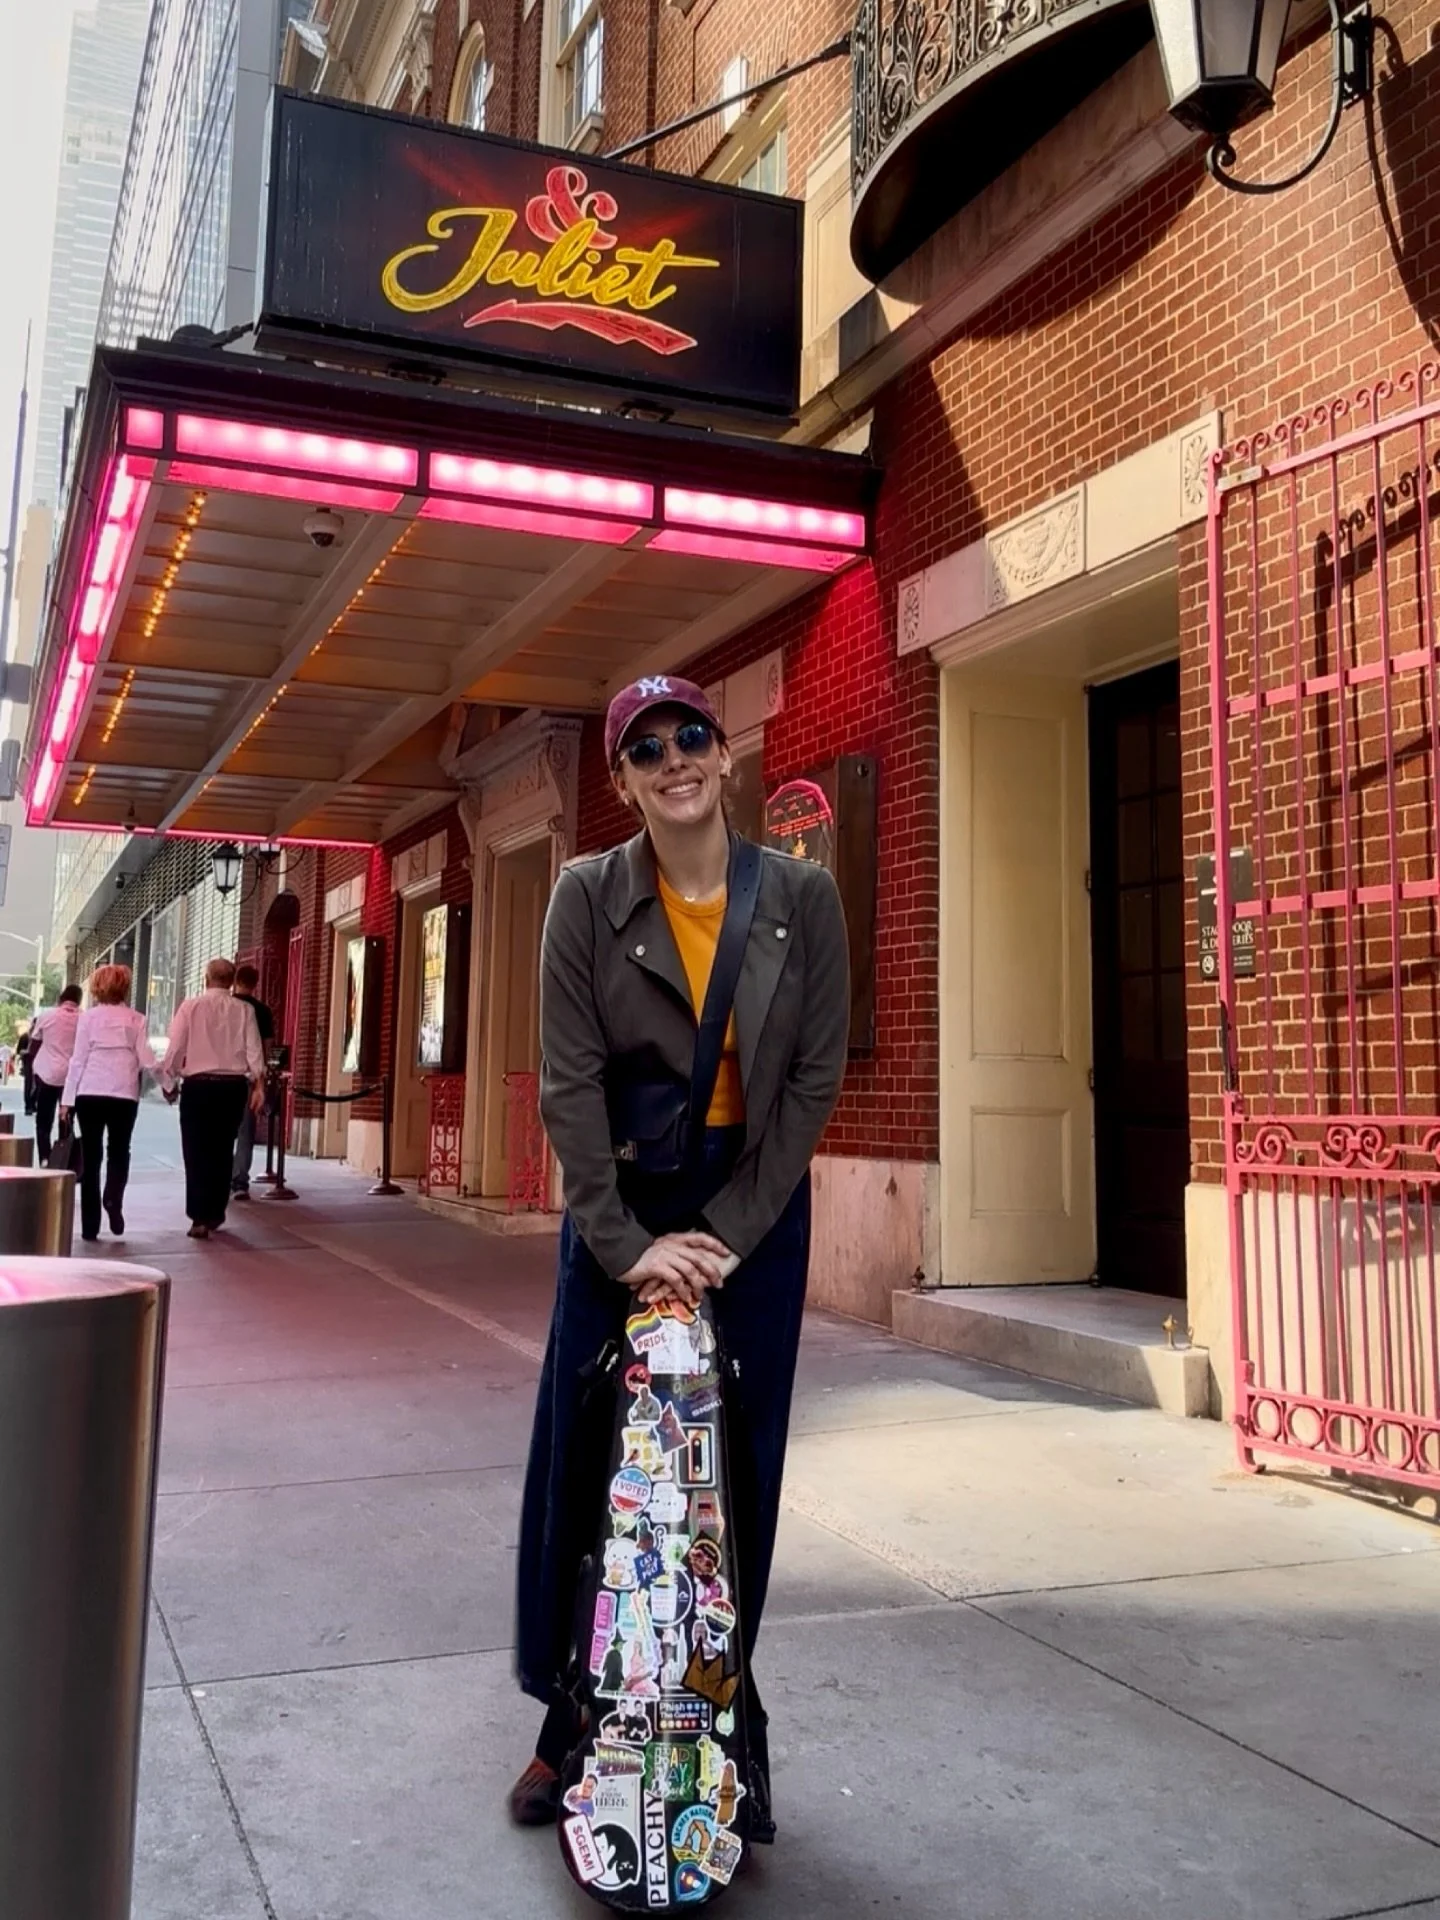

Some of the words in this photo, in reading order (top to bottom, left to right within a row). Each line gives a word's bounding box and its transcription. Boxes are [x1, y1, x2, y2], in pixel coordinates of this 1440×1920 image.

[526, 166, 618, 250] &
[382, 207, 720, 312] Juliet
[1232, 920, 1253, 933] OOR
[637, 1332, 667, 1351] PRIDE
[620, 1481, 649, 1497] VOTED
[646, 1791, 668, 1905] PEACHY
